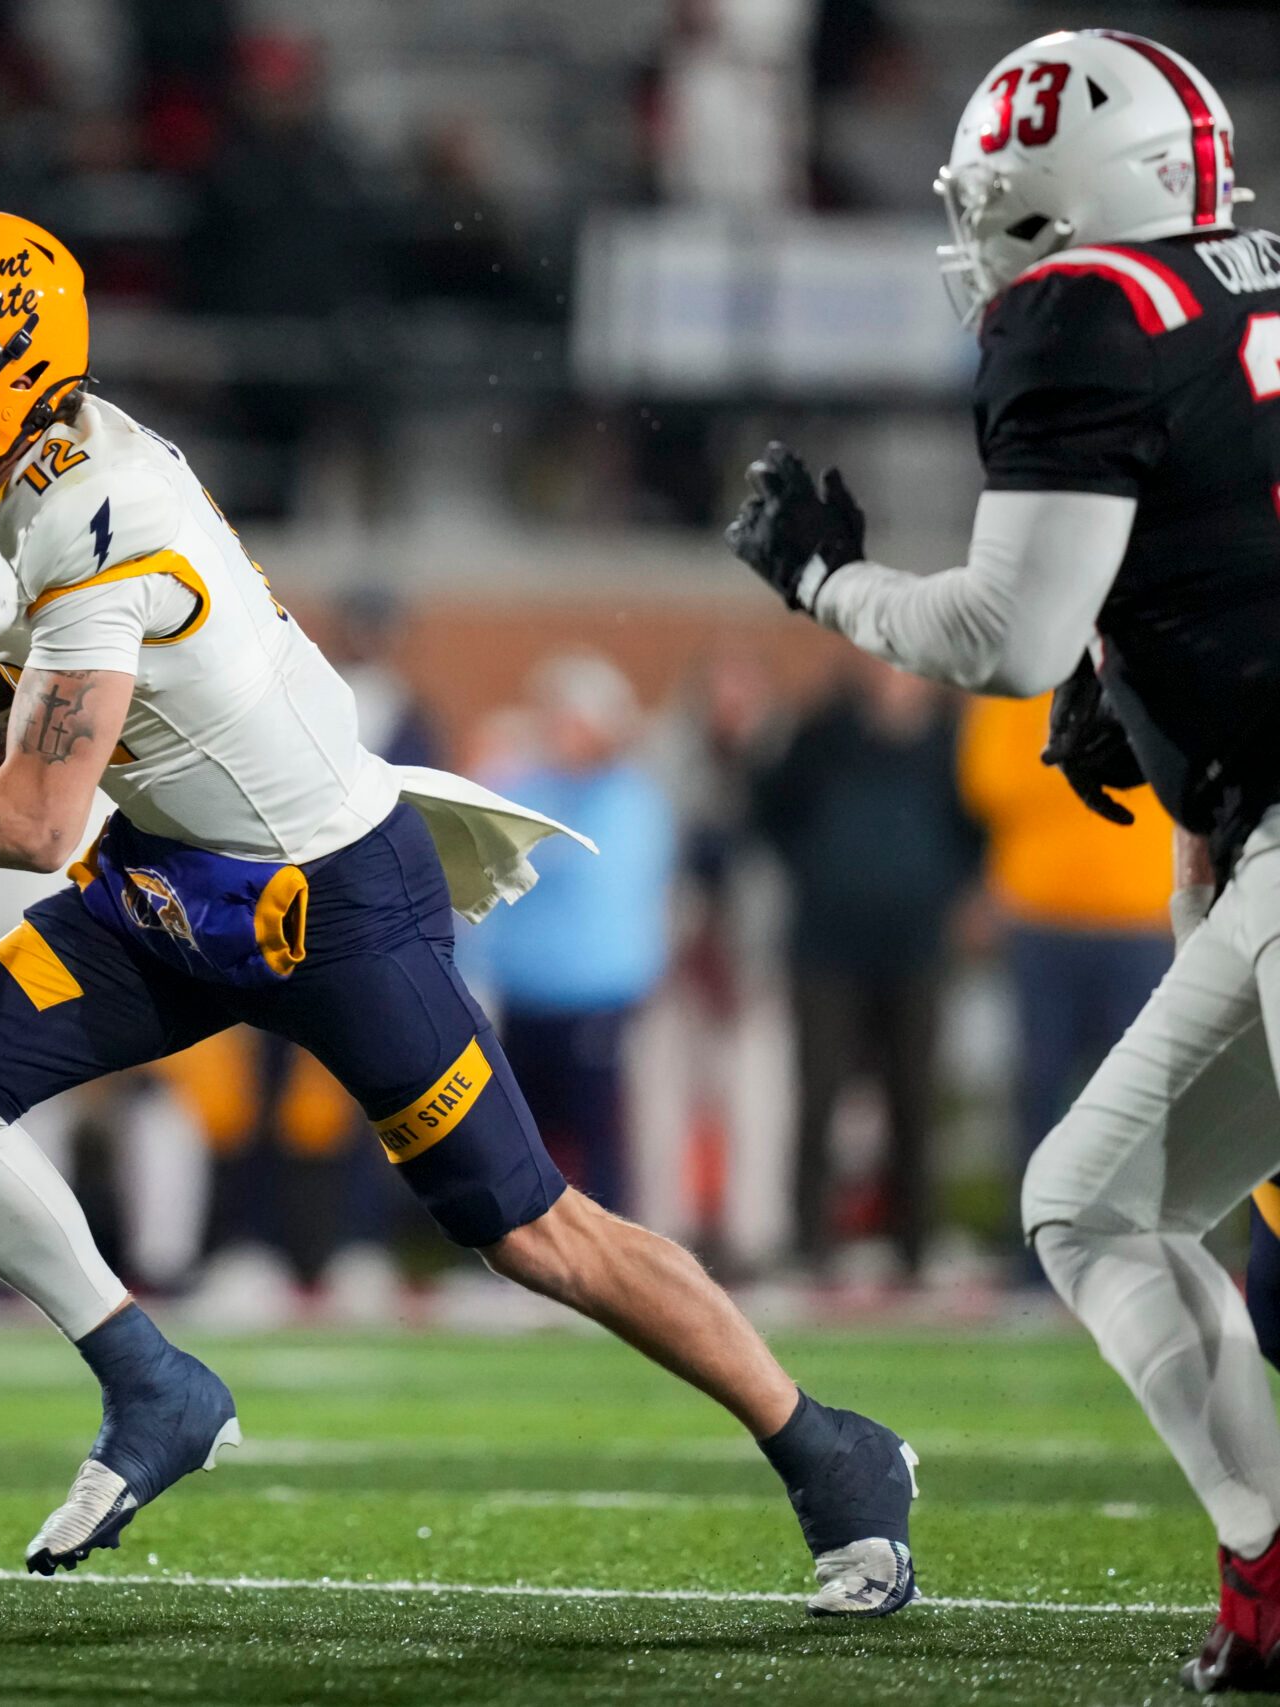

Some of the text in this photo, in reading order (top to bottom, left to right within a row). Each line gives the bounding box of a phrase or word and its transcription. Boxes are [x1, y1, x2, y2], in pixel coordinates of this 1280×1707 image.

[979, 62, 1071, 155] 33
[16, 437, 91, 497] 12
[417, 1071, 473, 1128] STATE
